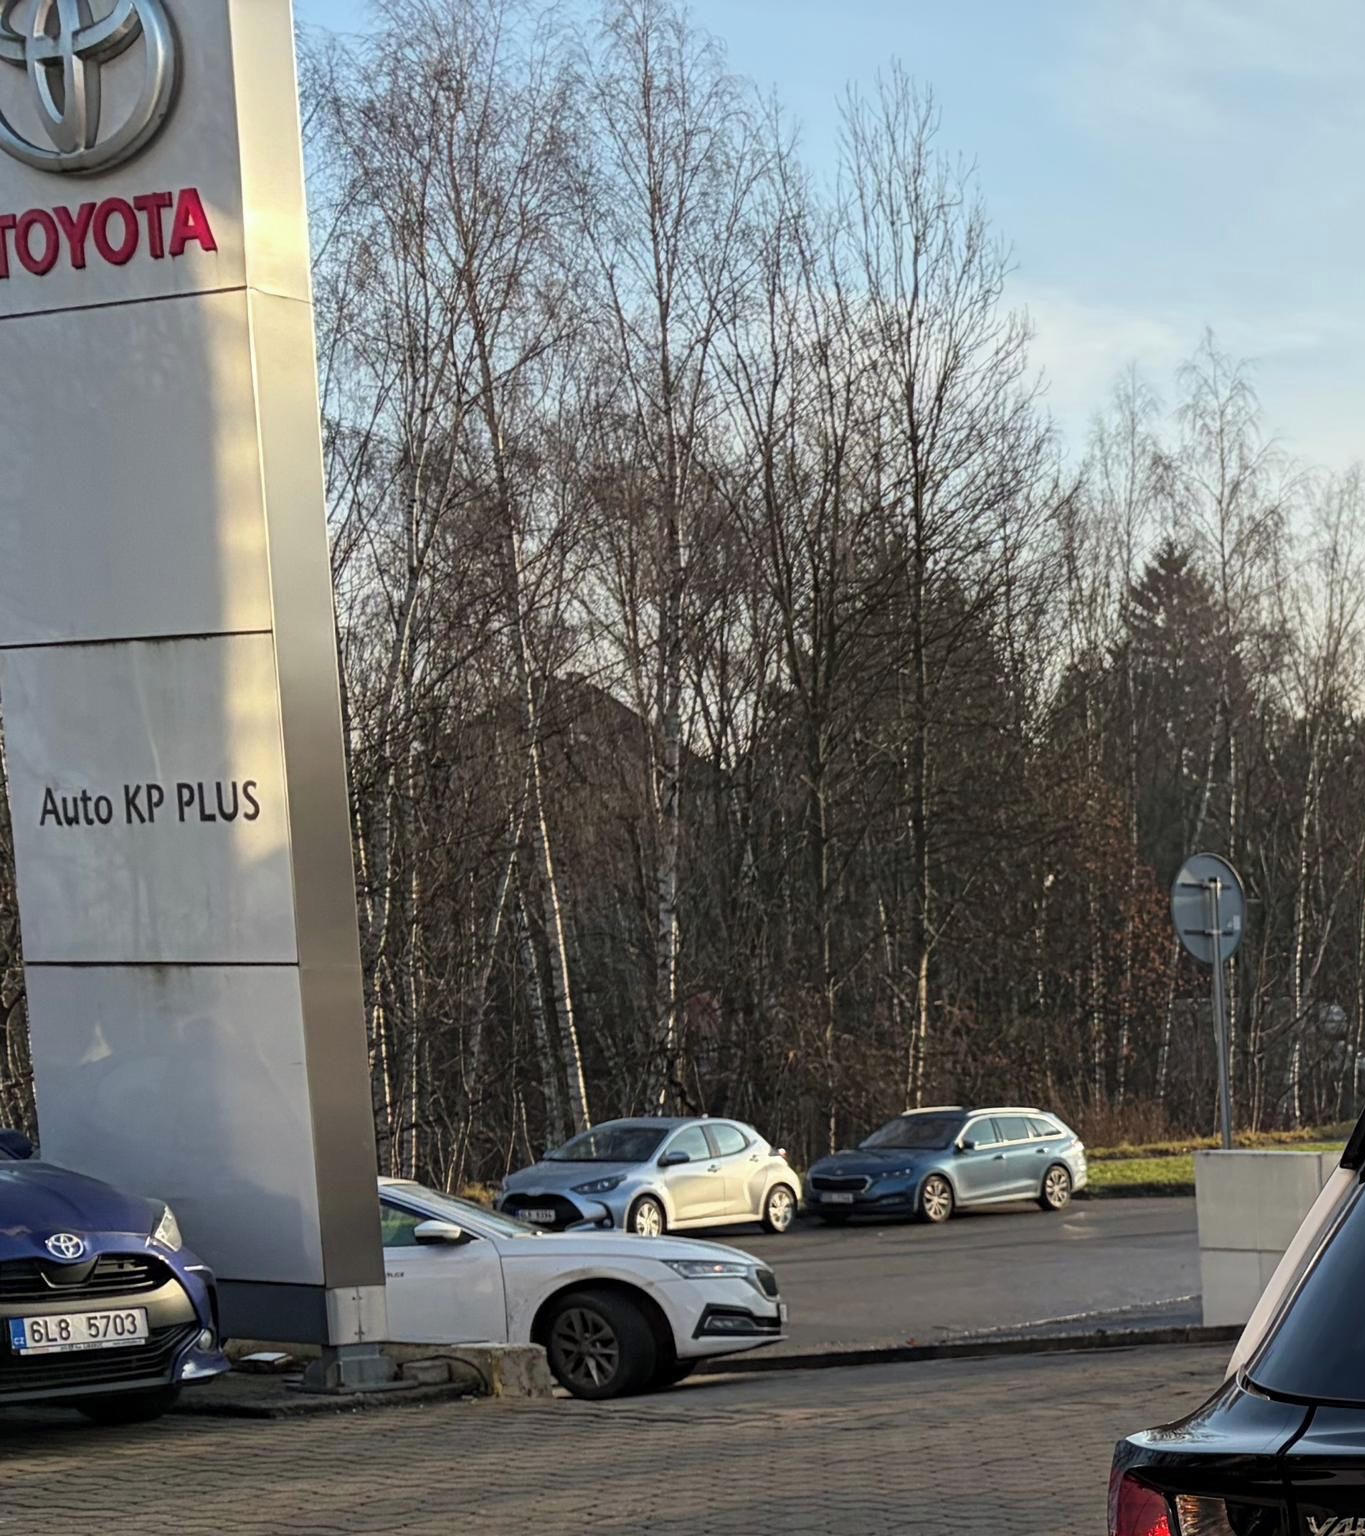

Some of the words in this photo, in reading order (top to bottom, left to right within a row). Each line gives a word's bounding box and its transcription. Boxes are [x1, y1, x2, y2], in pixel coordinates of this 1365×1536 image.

[39, 786, 113, 827] Auto
[123, 783, 165, 825] KP
[176, 780, 260, 822] PLUS
[30, 1319, 72, 1344] 6L8
[86, 1313, 137, 1338] 5703
